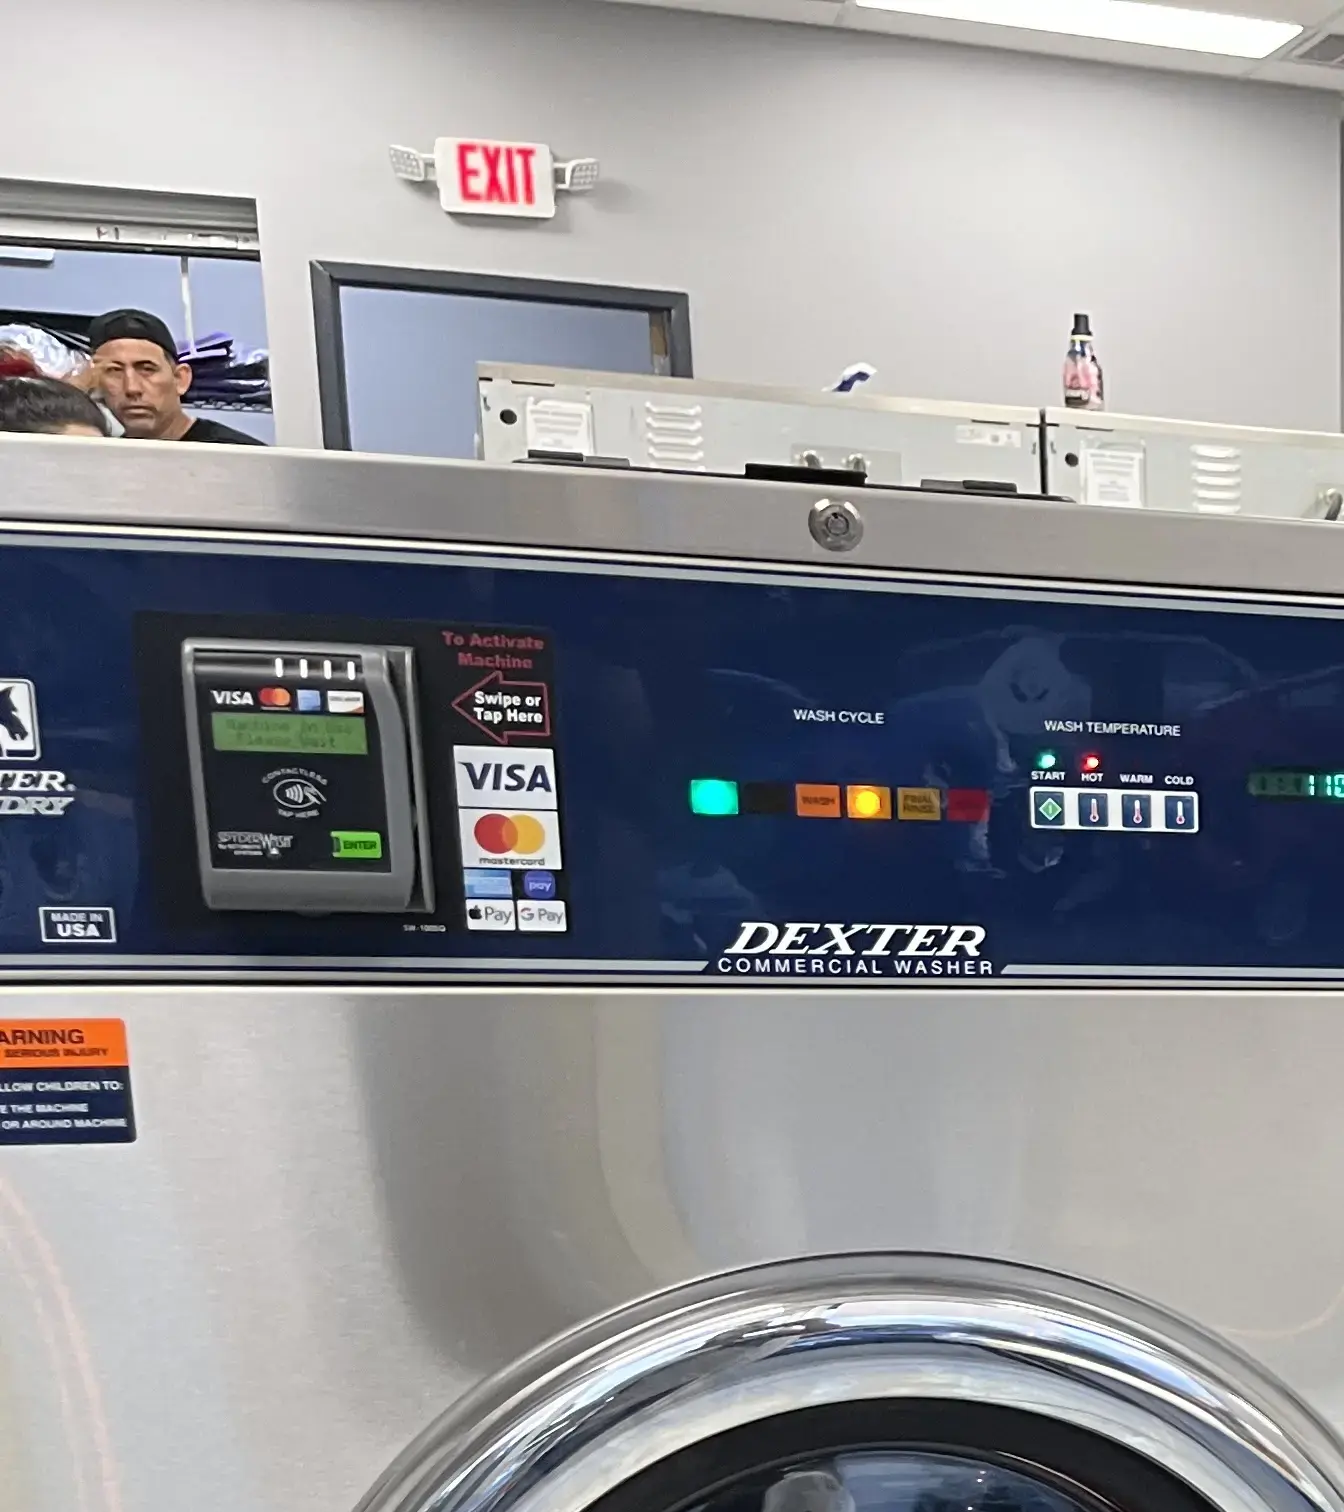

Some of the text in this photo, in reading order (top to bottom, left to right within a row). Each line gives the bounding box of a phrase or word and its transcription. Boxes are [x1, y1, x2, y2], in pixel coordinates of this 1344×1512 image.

[456, 142, 536, 206] EXIT
[441, 630, 545, 650] To Activate
[458, 652, 534, 670] Machine
[210, 690, 254, 706] VISA
[474, 690, 542, 709] Swipe or
[472, 707, 544, 724] Tap Here
[793, 708, 885, 725] WASH CYCLE
[1044, 719, 1182, 738] WASH TEMPERATURE
[458, 761, 552, 793] VISA
[1030, 770, 1066, 782] START
[1080, 772, 1104, 783] HOT
[1119, 774, 1154, 784] WARM
[1164, 774, 1194, 786] COLD
[342, 840, 377, 850] ENTER
[478, 856, 546, 866] mastercard
[528, 880, 552, 892] pay
[50, 912, 104, 922] MADE IN
[484, 906, 512, 925] Pay
[538, 910, 564, 924] Pay
[56, 923, 100, 938] USA
[723, 922, 986, 958] DEXTER
[718, 956, 994, 976] COMMERCIAL WASHER
[4, 1048, 109, 1058] SERIOUS INJURY
[35, 1080, 124, 1092] CHILDREN TO:
[11, 1102, 89, 1114] THE MACHINE
[2, 1118, 128, 1130] OR AROUND MACHINE
